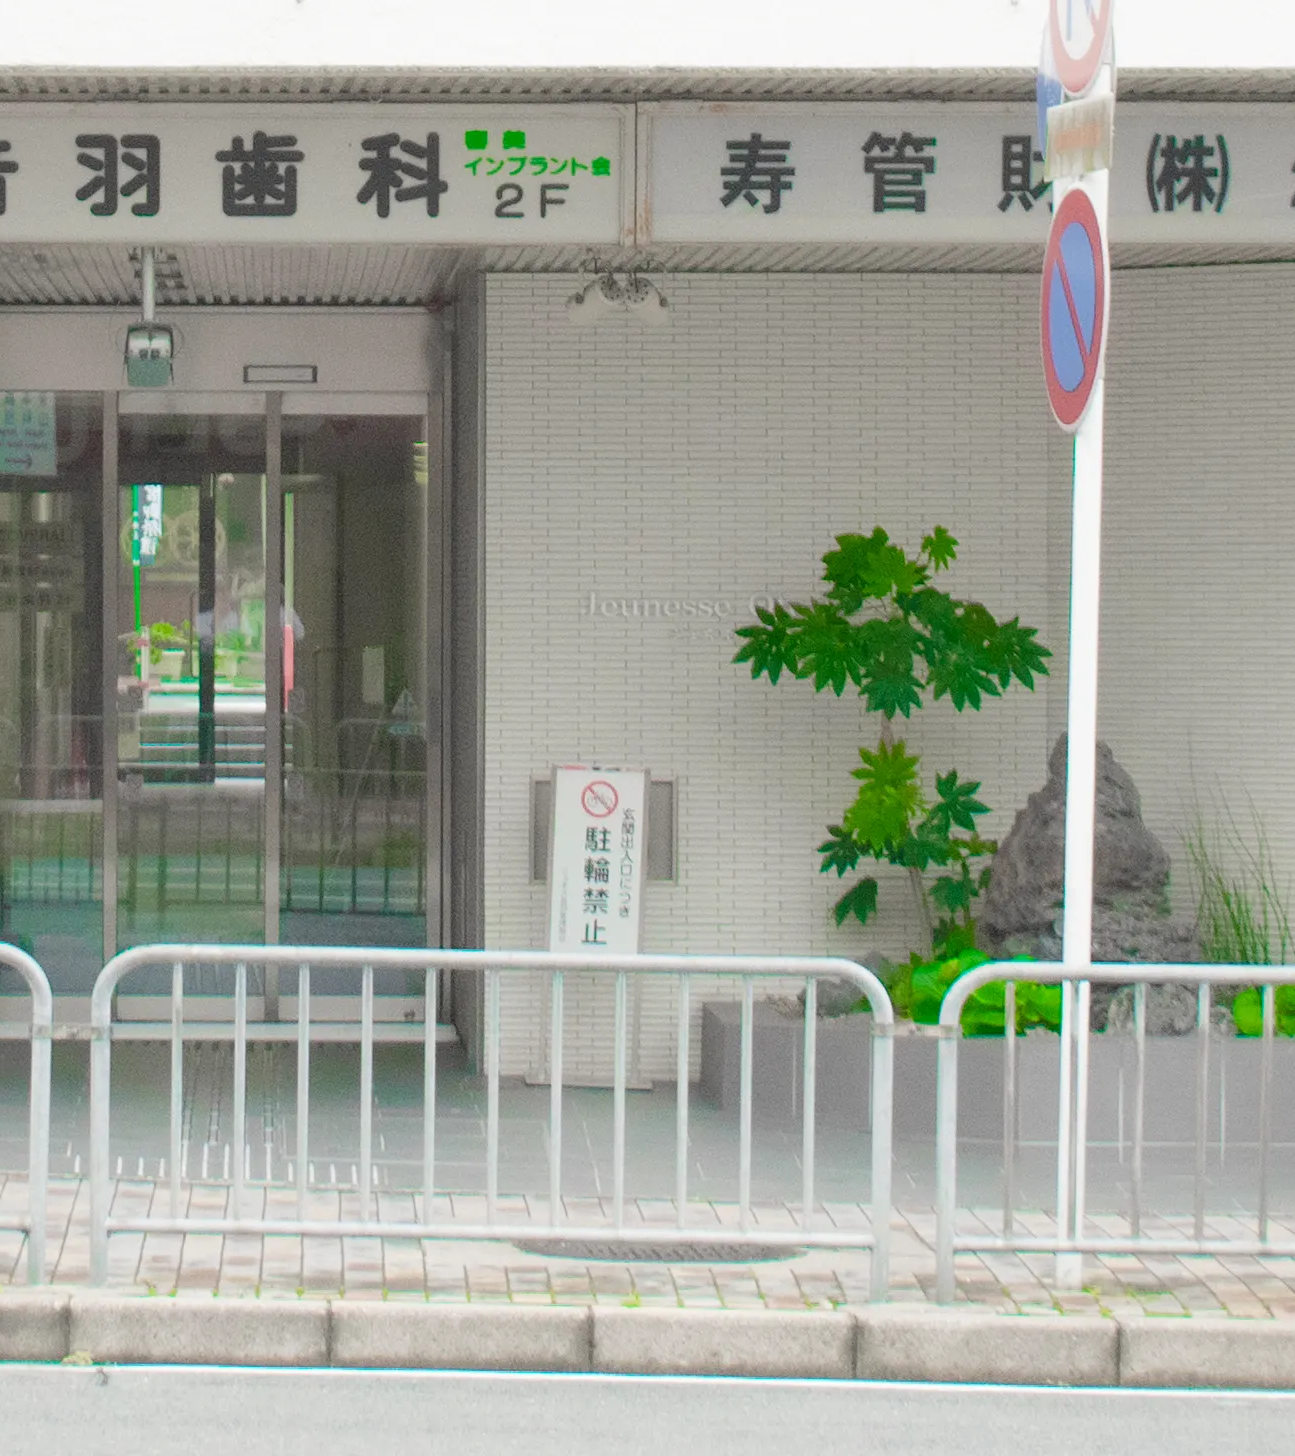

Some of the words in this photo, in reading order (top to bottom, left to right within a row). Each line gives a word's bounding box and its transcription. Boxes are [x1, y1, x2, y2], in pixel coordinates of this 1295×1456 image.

[495, 182, 570, 218] 2F
[582, 826, 612, 946] 駐輪禁止
